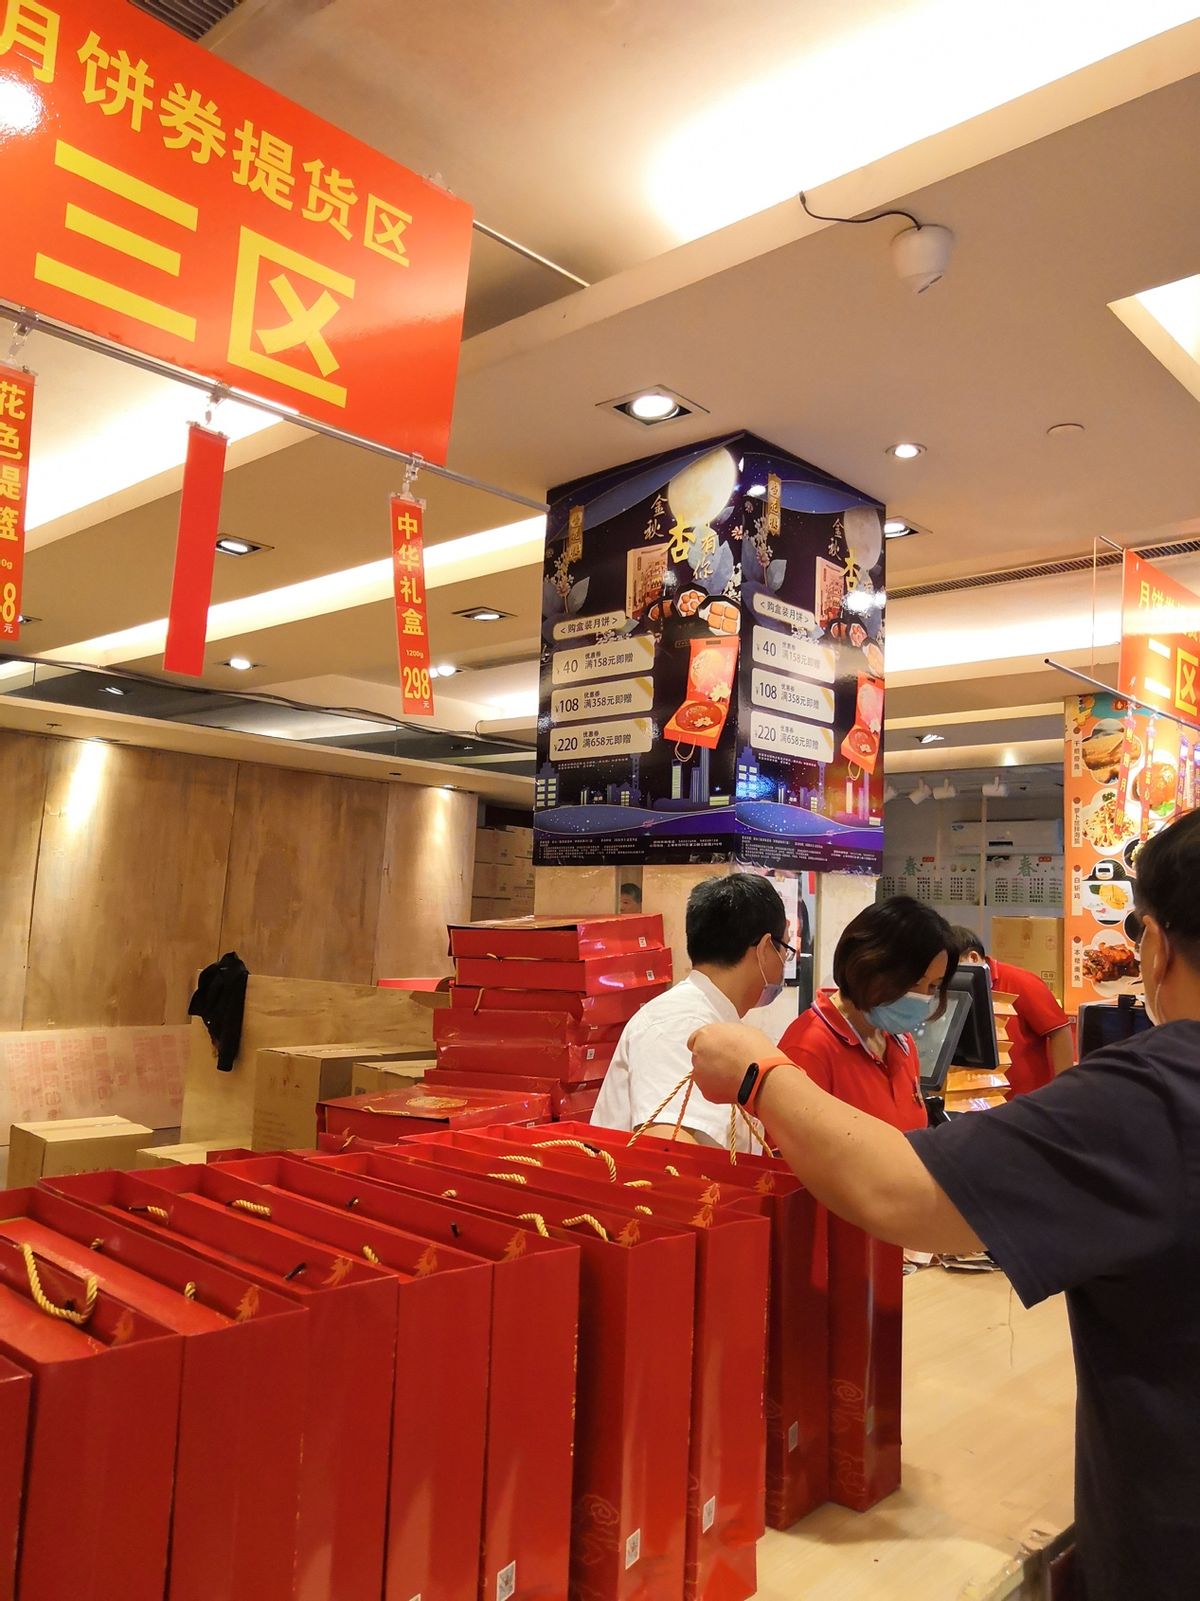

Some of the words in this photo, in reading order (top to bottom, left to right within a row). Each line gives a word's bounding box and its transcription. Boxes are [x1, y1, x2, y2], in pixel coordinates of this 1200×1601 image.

[0, 0, 414, 268] 月饼券提货区
[34, 138, 357, 409] 三区
[663, 514, 696, 564] 杏
[397, 512, 425, 637] 中华礼盒
[4, 623, 14, 634] 元
[405, 649, 424, 660] 1200g
[584, 653, 634, 670] 满158元即赠
[585, 651, 602, 660] 优惠券
[403, 666, 431, 700] 298
[1144, 637, 1200, 717] 二区
[583, 690, 601, 699] 优惠券
[583, 693, 633, 709] 满358元即赠
[423, 700, 430, 709] 元
[582, 730, 600, 738] 优惠券
[582, 733, 632, 749] 满658元即赠
[903, 855, 921, 877] 春
[1018, 855, 1037, 877] 春
